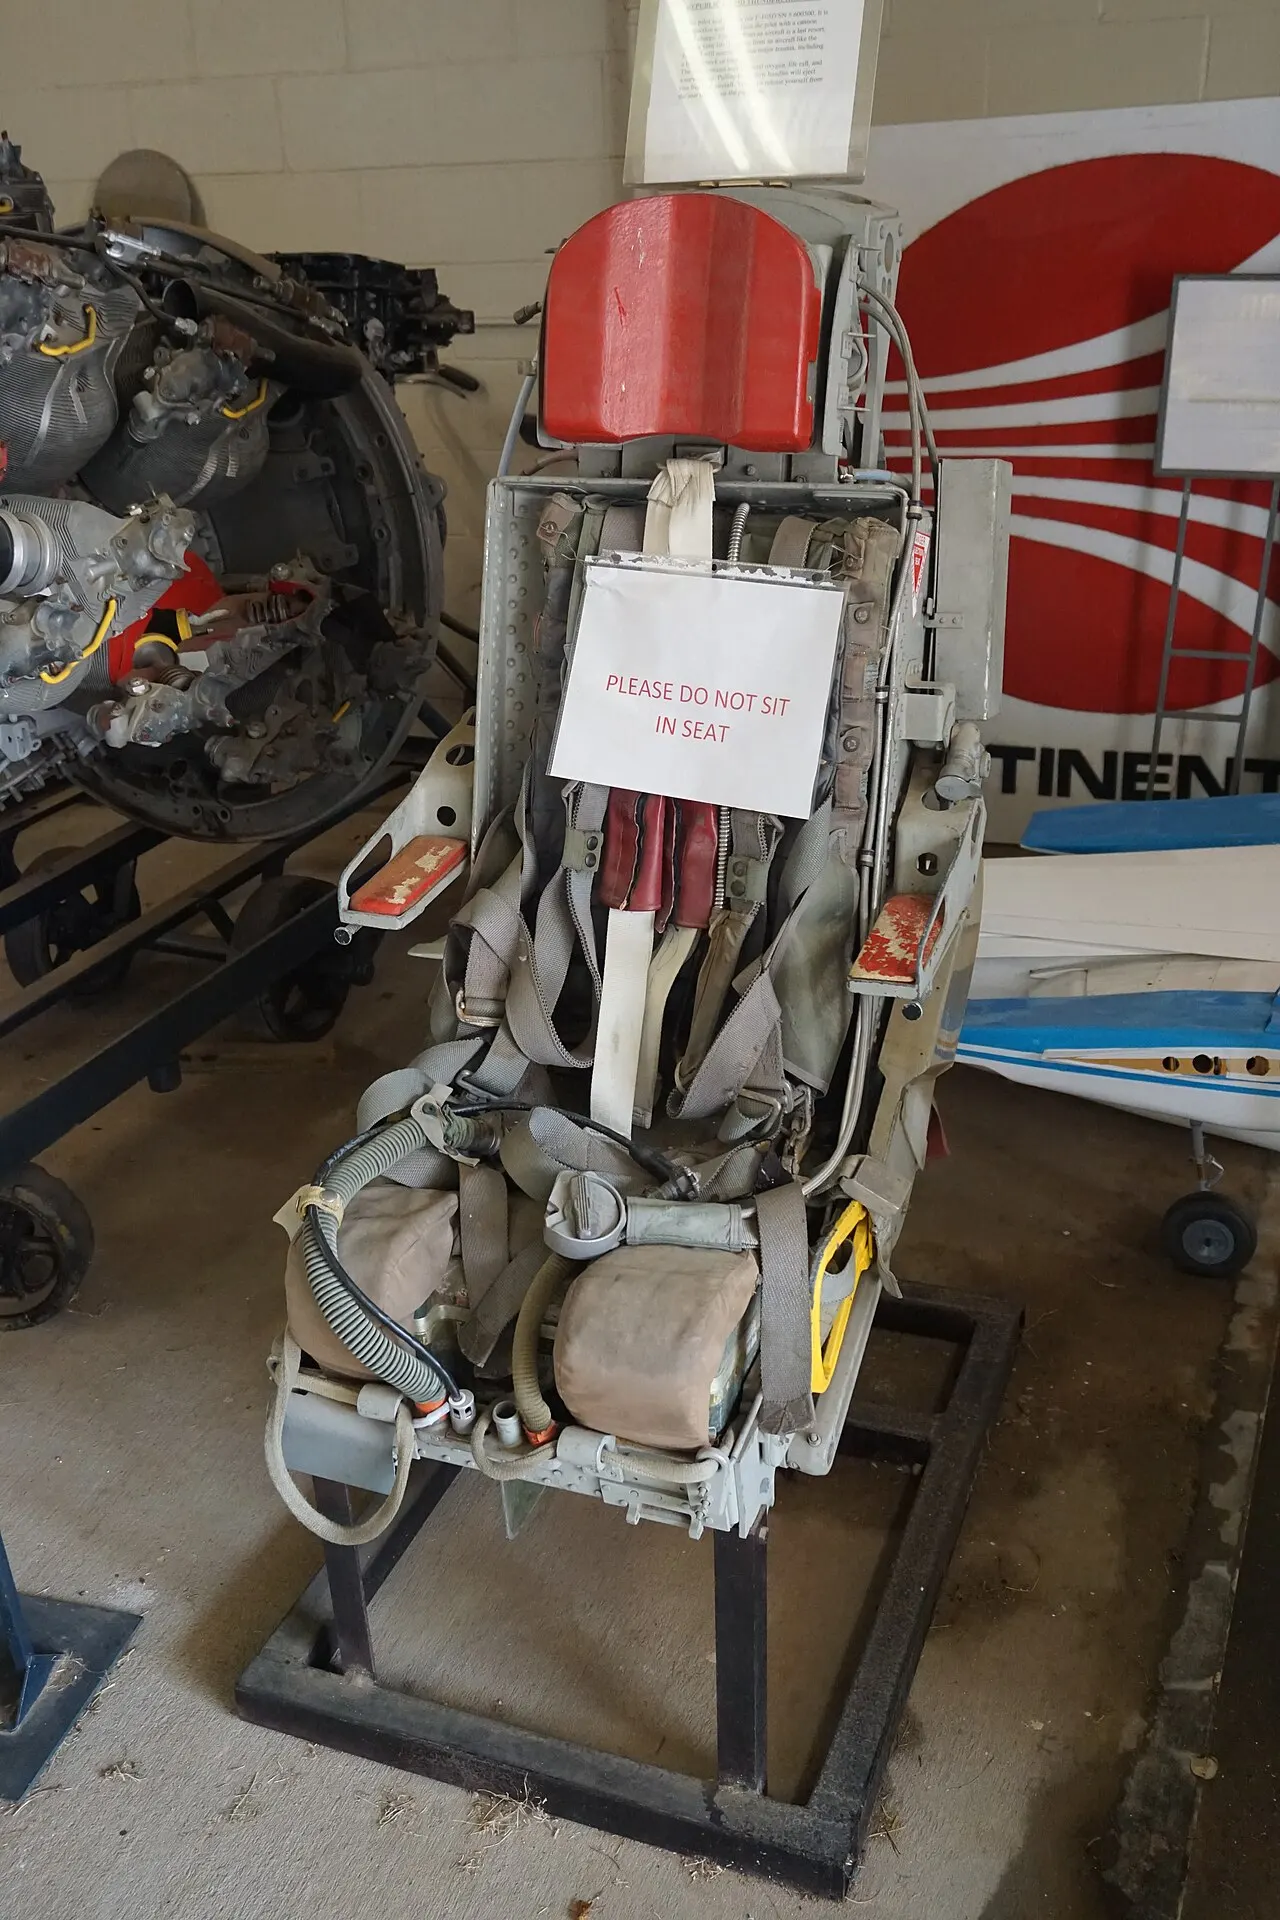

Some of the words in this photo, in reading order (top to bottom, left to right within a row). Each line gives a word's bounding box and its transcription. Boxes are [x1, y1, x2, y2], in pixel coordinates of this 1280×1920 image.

[797, 43, 824, 51] including
[802, 68, 816, 77] eject
[785, 77, 808, 86] yourself
[606, 675, 674, 701] PLEASE
[680, 684, 708, 705] DO
[714, 689, 757, 712] NOT
[760, 696, 790, 716] SIT
[655, 715, 677, 735] IN
[681, 720, 730, 743] SEAT
